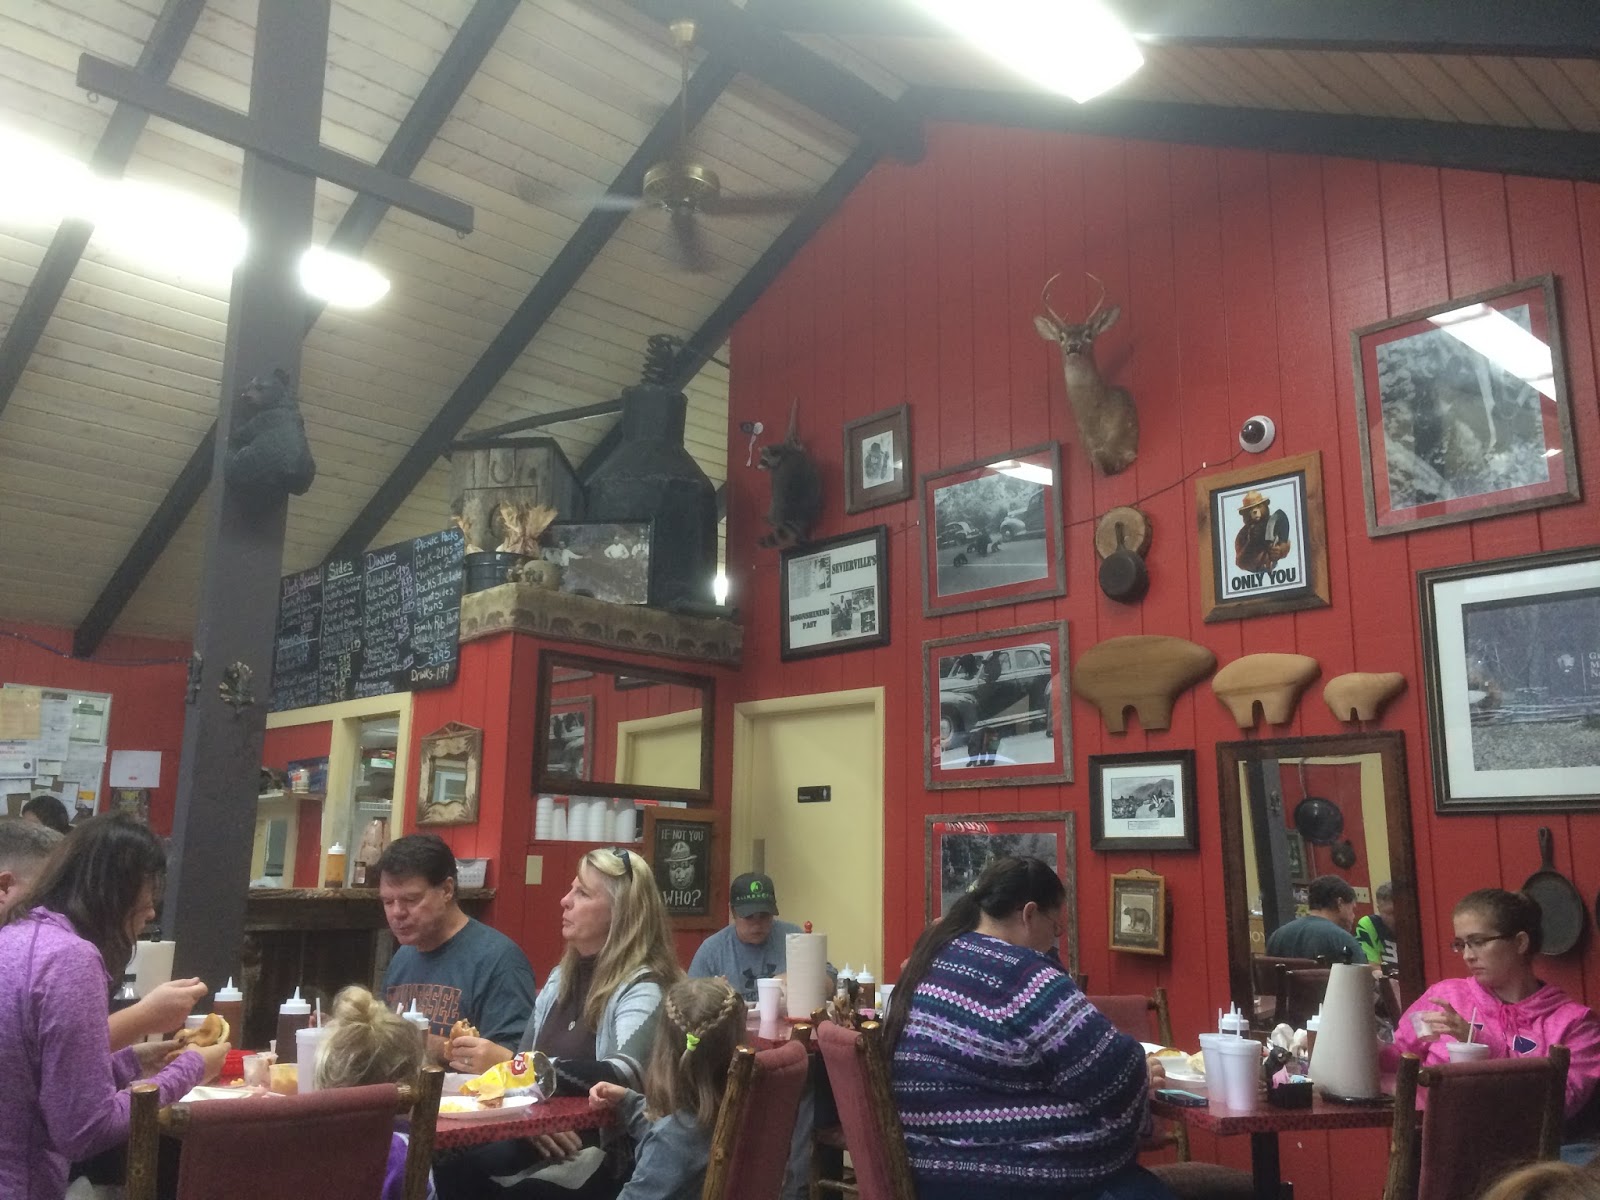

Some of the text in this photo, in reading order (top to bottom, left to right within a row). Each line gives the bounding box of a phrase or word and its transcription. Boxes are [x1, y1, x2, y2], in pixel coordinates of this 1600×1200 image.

[329, 560, 353, 579] Sides
[831, 554, 877, 575] SEVIERVILLE'S
[1232, 567, 1296, 591] ONLY YOU
[802, 620, 817, 629] PAST
[661, 828, 704, 841] IF NOT YOU
[663, 889, 702, 907] WHO?
